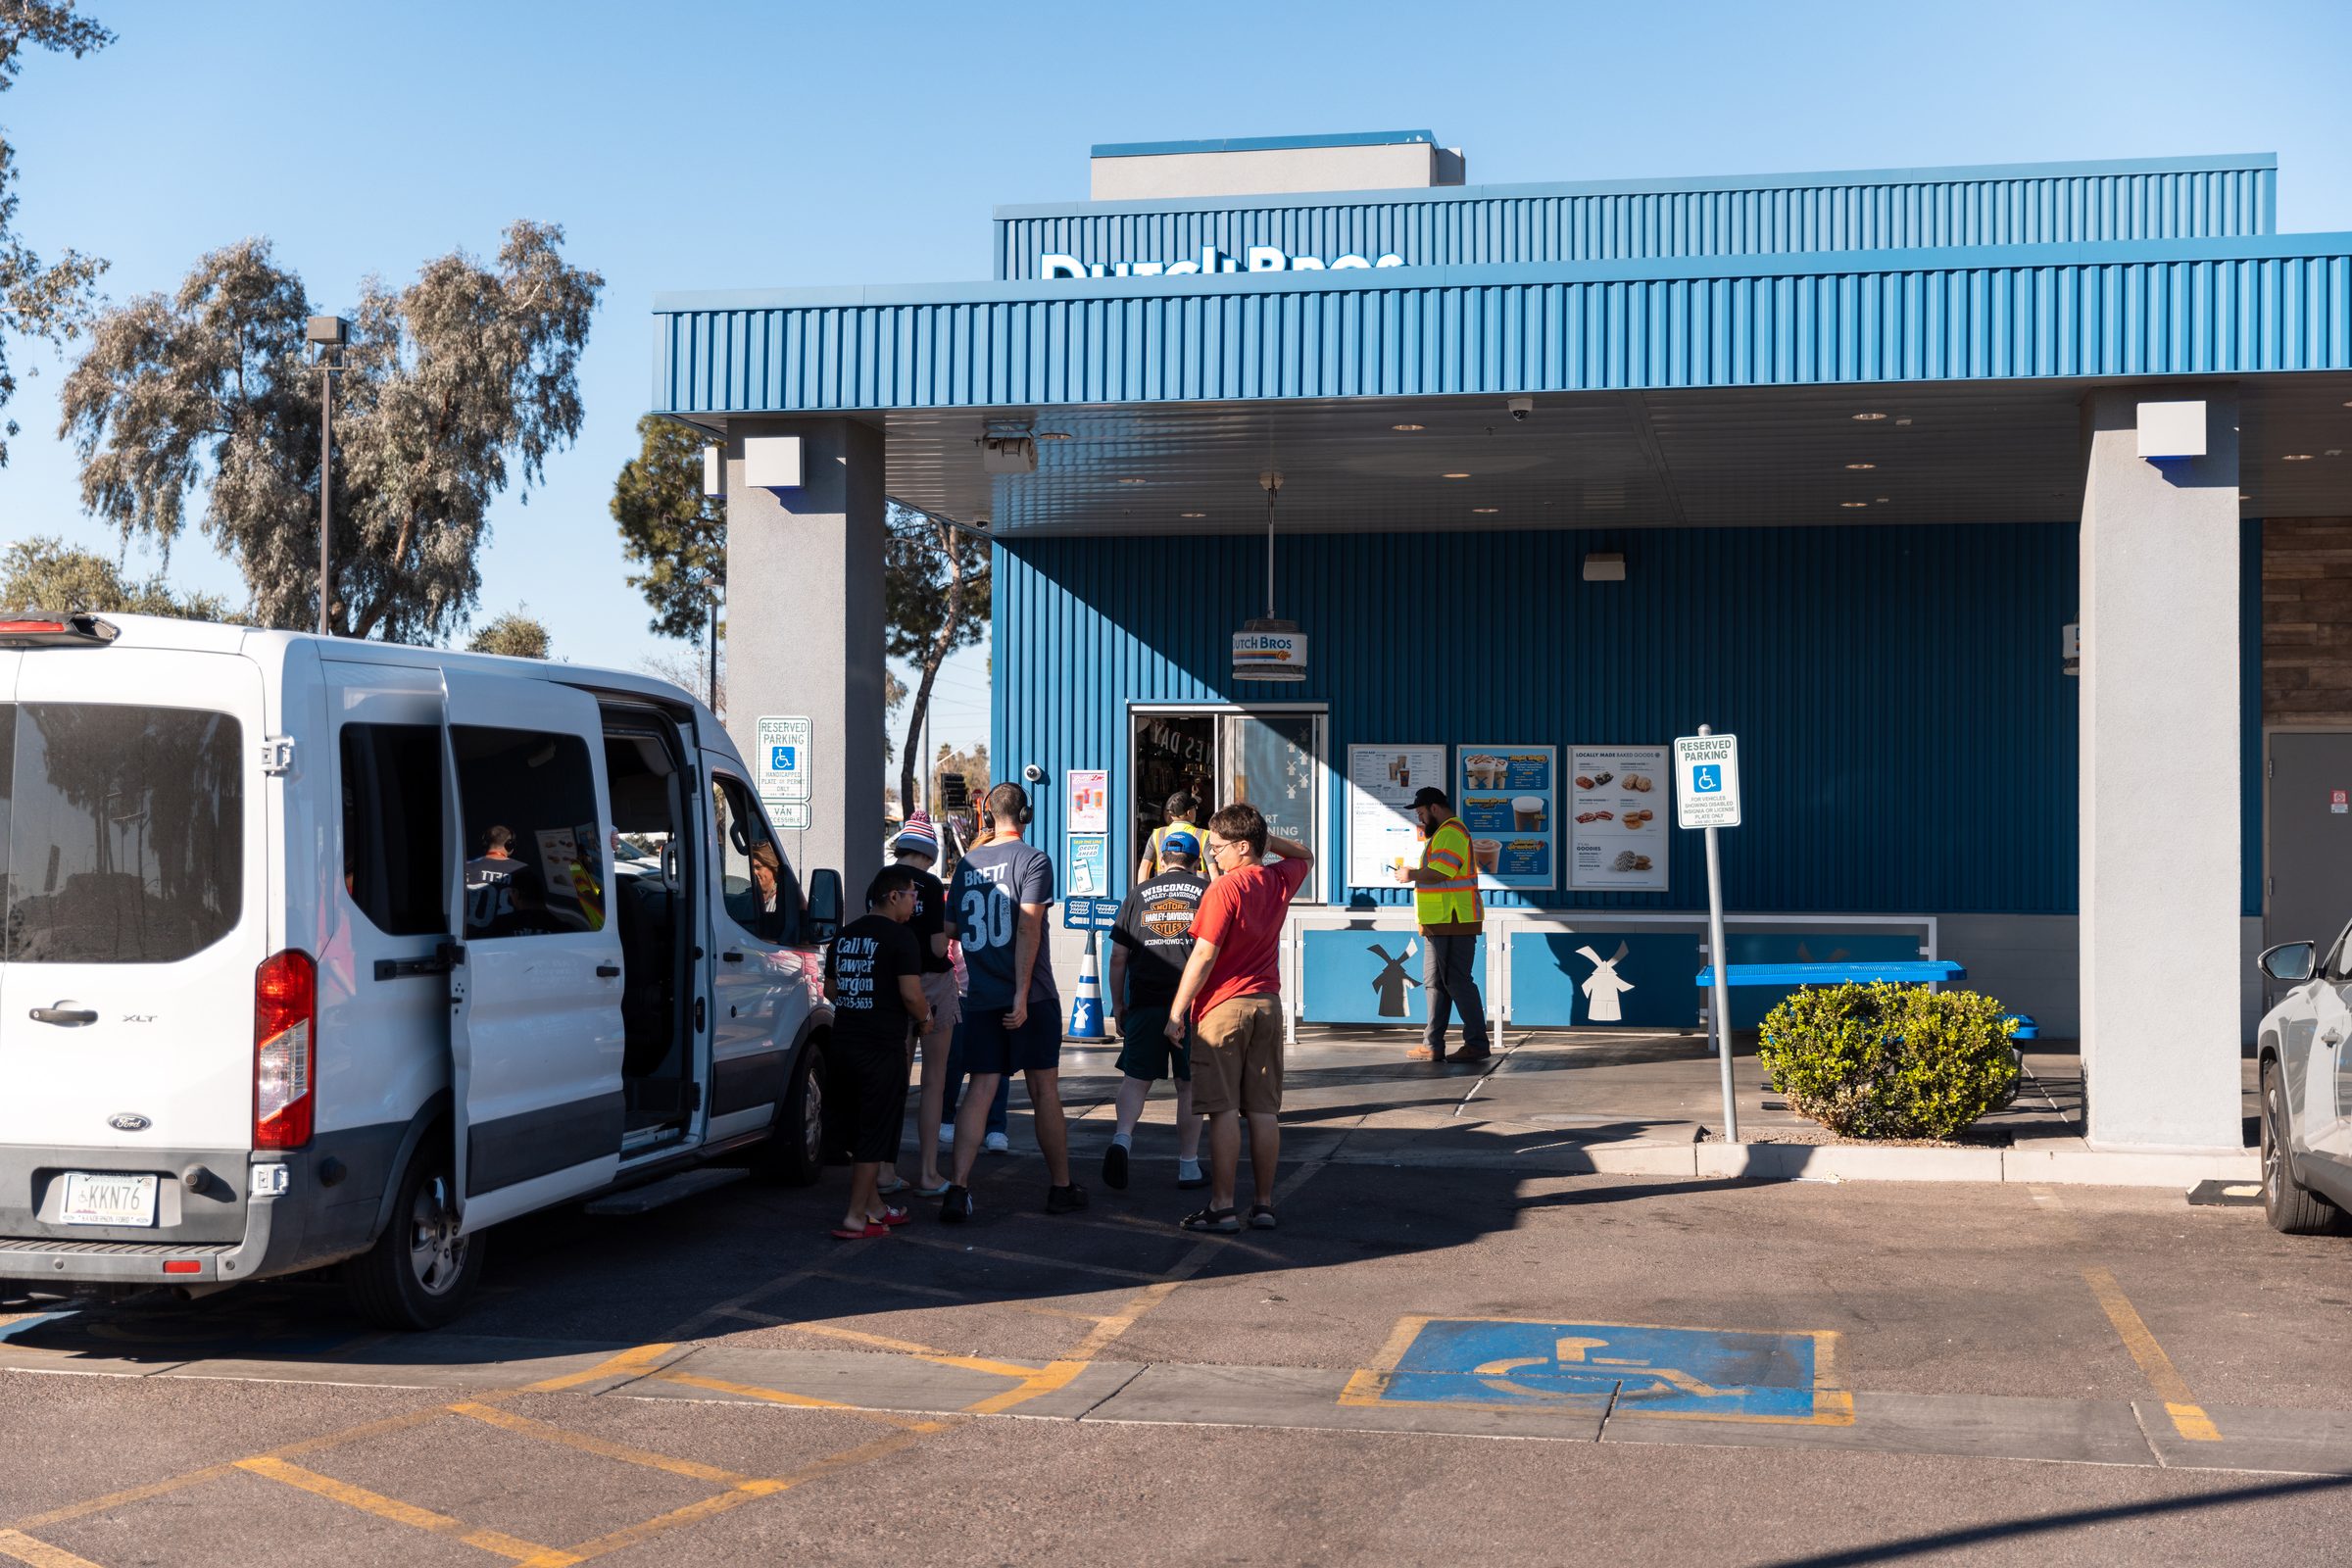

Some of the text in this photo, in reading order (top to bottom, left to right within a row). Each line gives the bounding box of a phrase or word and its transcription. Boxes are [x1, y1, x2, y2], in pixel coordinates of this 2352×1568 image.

[760, 722, 807, 733] RESERVED
[763, 734, 805, 745] PARKING
[1680, 740, 1732, 752] RESERVED
[1685, 750, 1728, 761] PARKING
[964, 862, 1008, 887] BRETT
[1141, 883, 1203, 898] WISCONSIN
[1144, 892, 1199, 903] HARLEY-DAVIDSON
[961, 883, 1012, 953] 30
[1145, 911, 1194, 922] HARLEY-DAVIDSON
[1156, 923, 1182, 934] CYCLES
[837, 937, 879, 959] Call My
[836, 955, 875, 977] Lawyer
[837, 973, 874, 996] Sargon
[117, 1116, 142, 1129] Ford
[89, 1185, 140, 1210] KKN76
